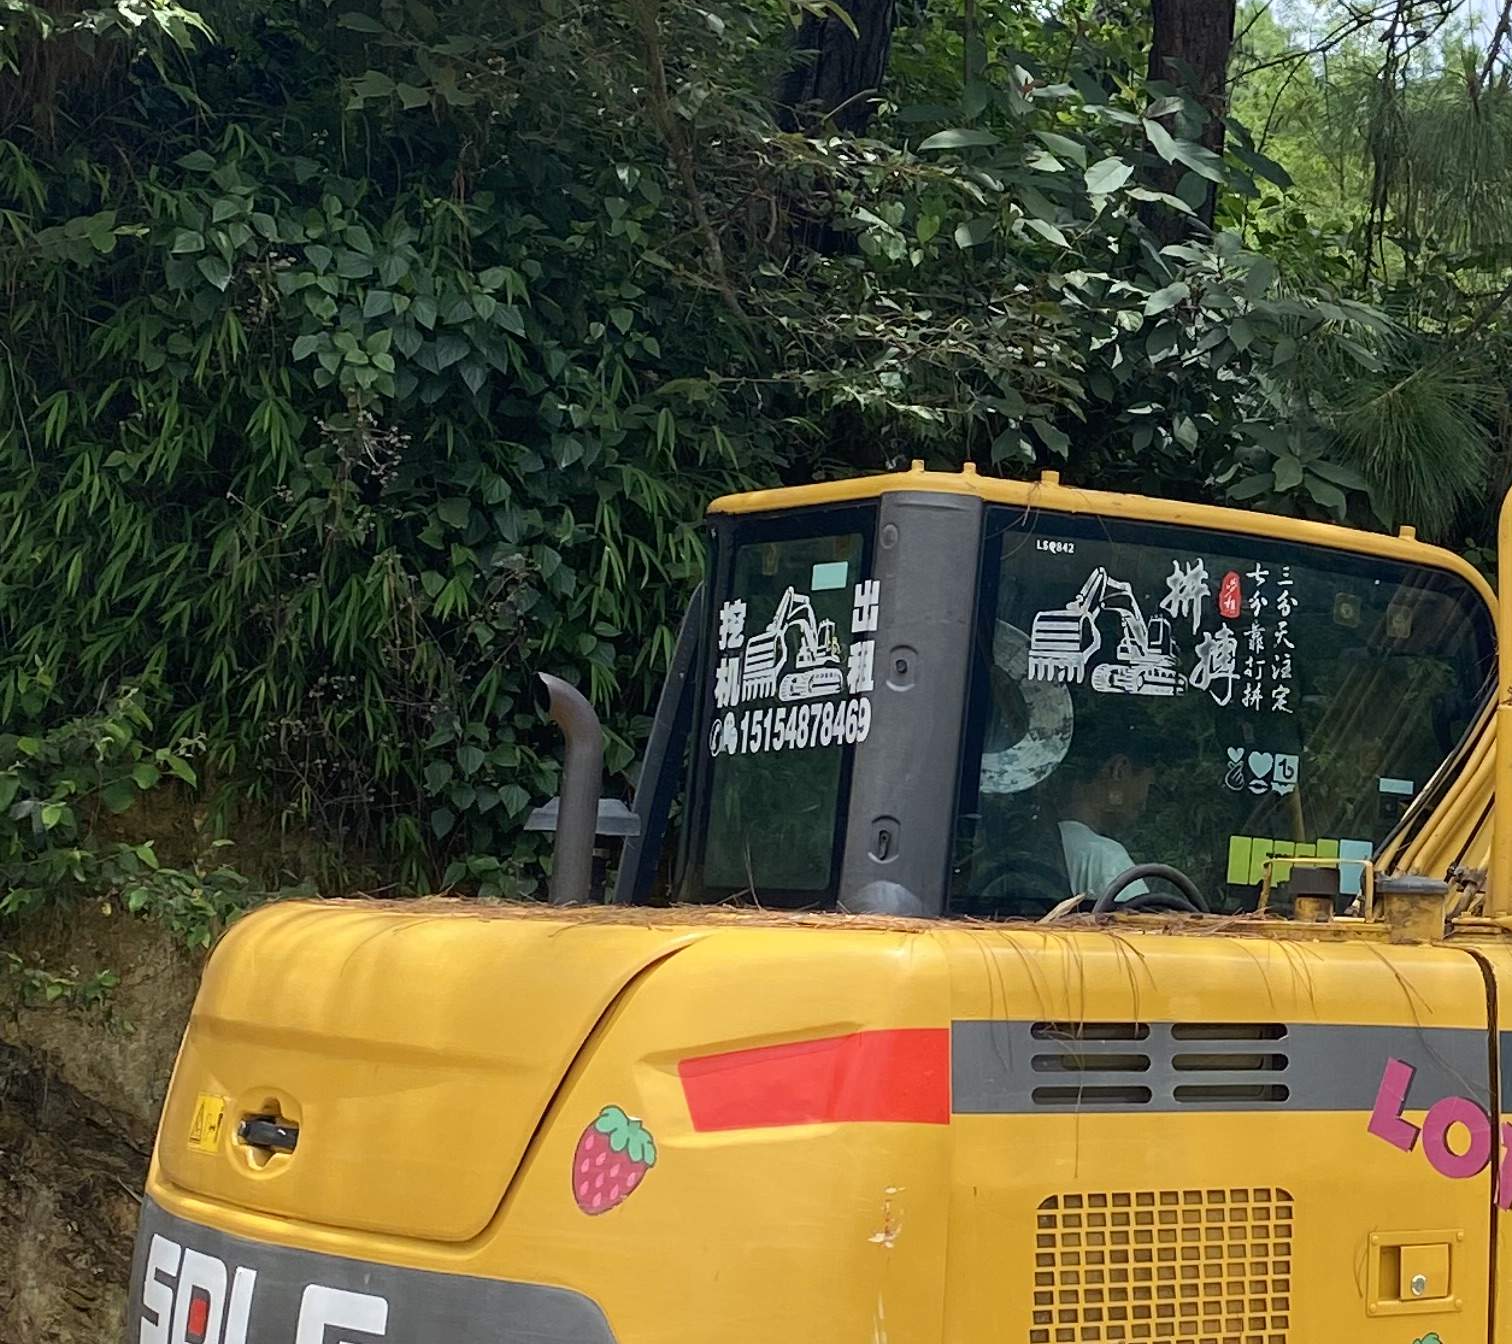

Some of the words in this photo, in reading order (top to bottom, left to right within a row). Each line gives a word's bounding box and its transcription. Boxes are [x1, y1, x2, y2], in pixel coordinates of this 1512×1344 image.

[847, 579, 881, 694] 出租
[1241, 562, 1270, 712] 七分靠打拼
[1271, 566, 1299, 714] 三分天注定
[740, 697, 872, 755] 15154878469
